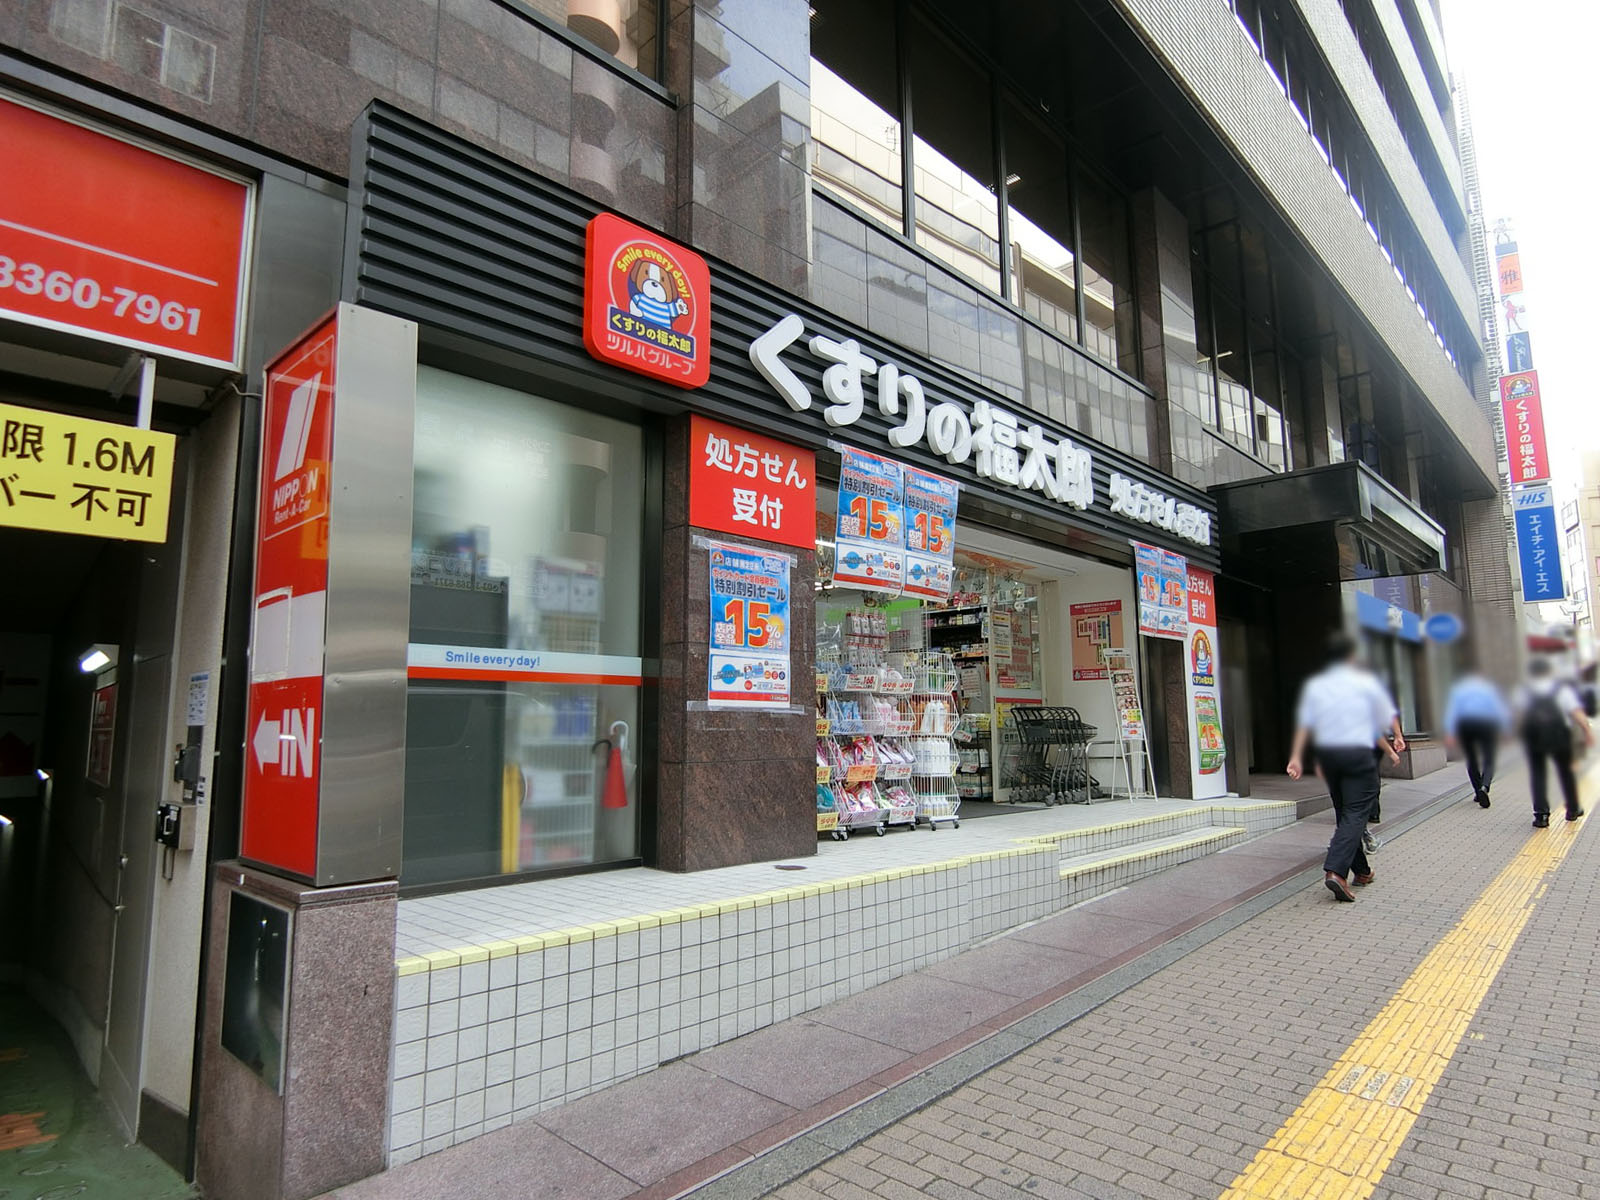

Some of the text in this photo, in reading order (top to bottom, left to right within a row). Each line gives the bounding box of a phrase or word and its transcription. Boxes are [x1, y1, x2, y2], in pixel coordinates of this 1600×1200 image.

[617, 247, 691, 299] Smile every day!
[606, 333, 696, 375] ツルハグループ
[611, 313, 692, 354] くすりの福太郎
[749, 313, 1094, 511] くすりの福太郎
[63, 432, 156, 478] 1.6M
[705, 433, 807, 489] 処方せん
[1515, 400, 1537, 479] くすりの福太郎
[272, 467, 319, 511] NIPPON
[732, 487, 784, 530] 受付
[1518, 491, 1546, 505] HIS
[1528, 514, 1550, 593] エイチ・アイ・エス
[714, 578, 786, 601] 特別割引セール
[1191, 599, 1206, 619] 受付
[445, 651, 481, 664] Smile
[281, 707, 315, 778] IN
